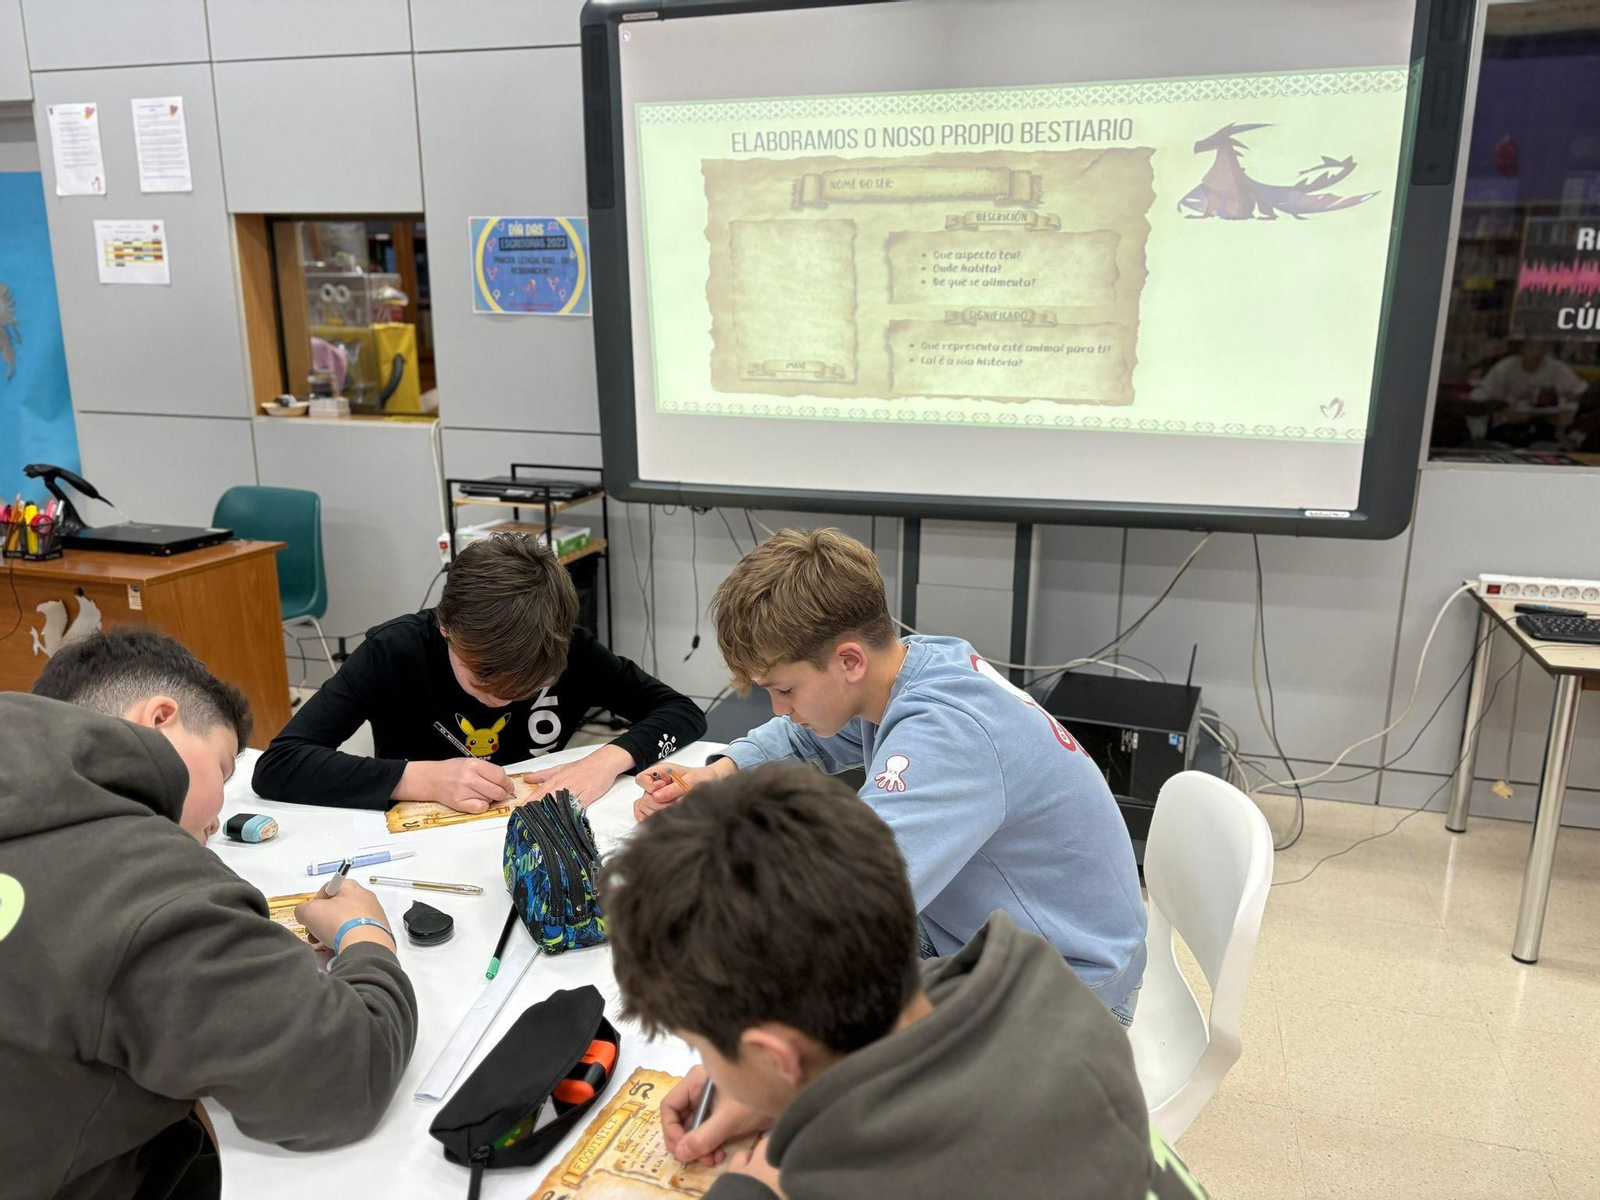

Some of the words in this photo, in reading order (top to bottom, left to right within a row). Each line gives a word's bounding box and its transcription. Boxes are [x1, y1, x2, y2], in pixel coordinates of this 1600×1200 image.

[731, 128, 859, 153] ELABORAMOS
[864, 127, 876, 149] O
[882, 125, 935, 148] NOSO
[941, 122, 1014, 146] PROPIO
[1020, 118, 1134, 144] BESTIARIO
[830, 178, 856, 190] NOME
[859, 178, 873, 189] DO
[976, 209, 1028, 222] DESCRICIÓN
[508, 220, 524, 236] DÍA
[525, 223, 544, 236] DAS
[933, 250, 953, 260] Que
[955, 250, 997, 261] aspecto
[999, 250, 1021, 260] ten?
[932, 263, 958, 274] Onde
[961, 264, 1002, 274] habita?
[933, 277, 945, 287] De
[948, 278, 967, 289] que
[969, 279, 980, 287] se
[982, 277, 1036, 288] alimenta?
[969, 309, 1028, 321] SIGNIFICADO
[921, 341, 939, 351] Que
[942, 341, 1000, 353] representa
[1002, 343, 1024, 352] este
[1025, 343, 1064, 353] animal
[1066, 345, 1095, 355] para
[1097, 344, 1112, 354] ti?
[956, 356, 974, 366] súa
[976, 356, 1023, 367] historia?
